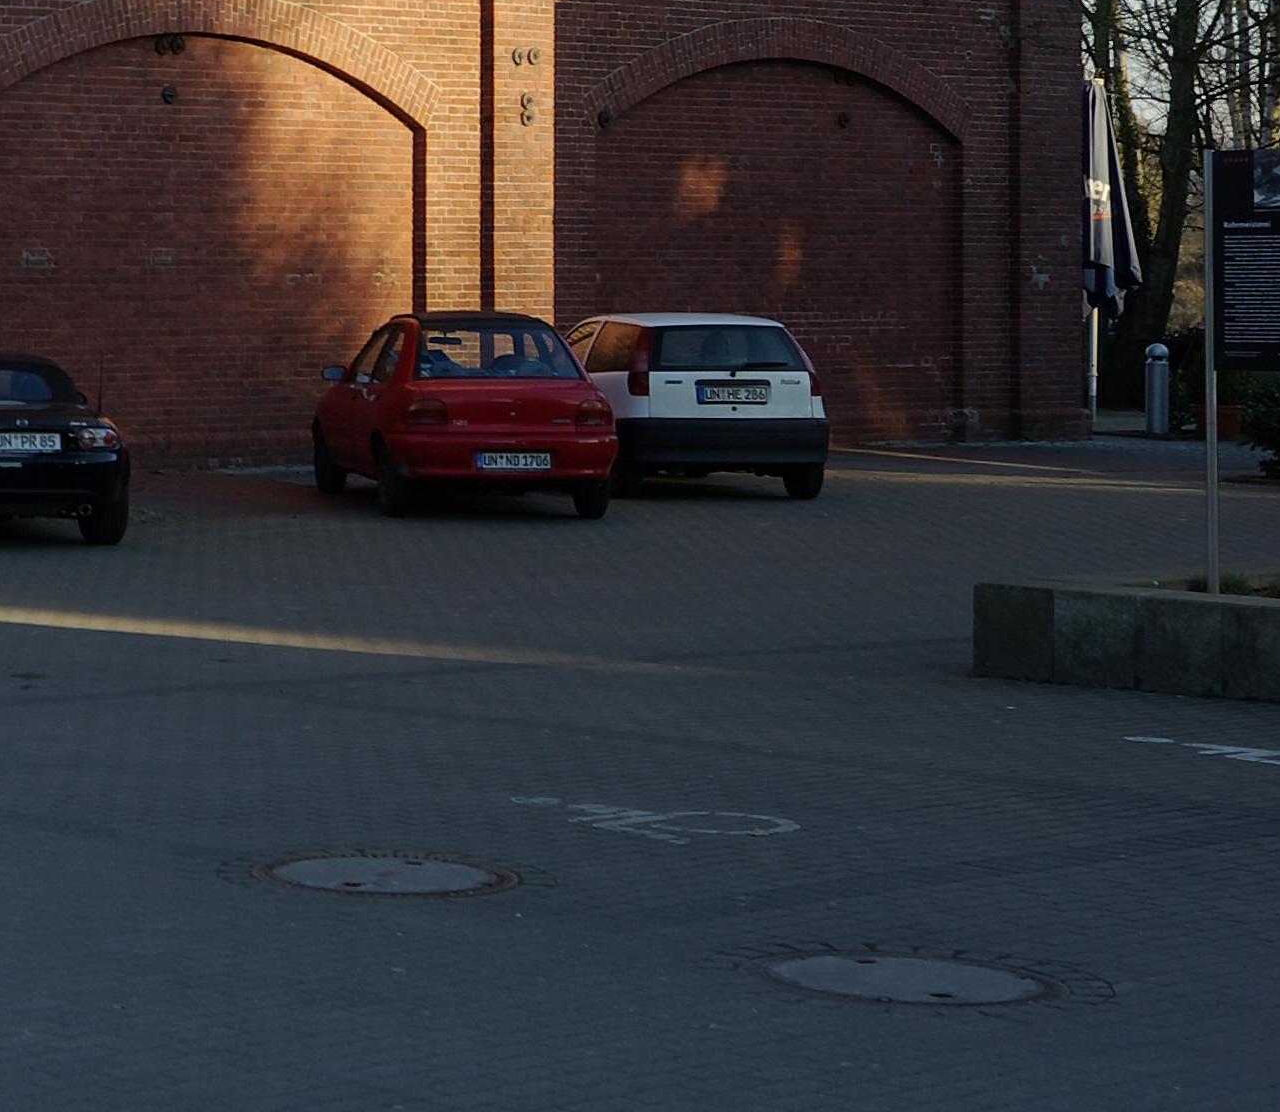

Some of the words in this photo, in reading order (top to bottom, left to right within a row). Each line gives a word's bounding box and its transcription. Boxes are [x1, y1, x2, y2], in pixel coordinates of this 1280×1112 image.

[20, 435, 37, 448] PR
[40, 435, 56, 448] 85
[483, 455, 498, 466] UN
[523, 455, 549, 466] 1706
